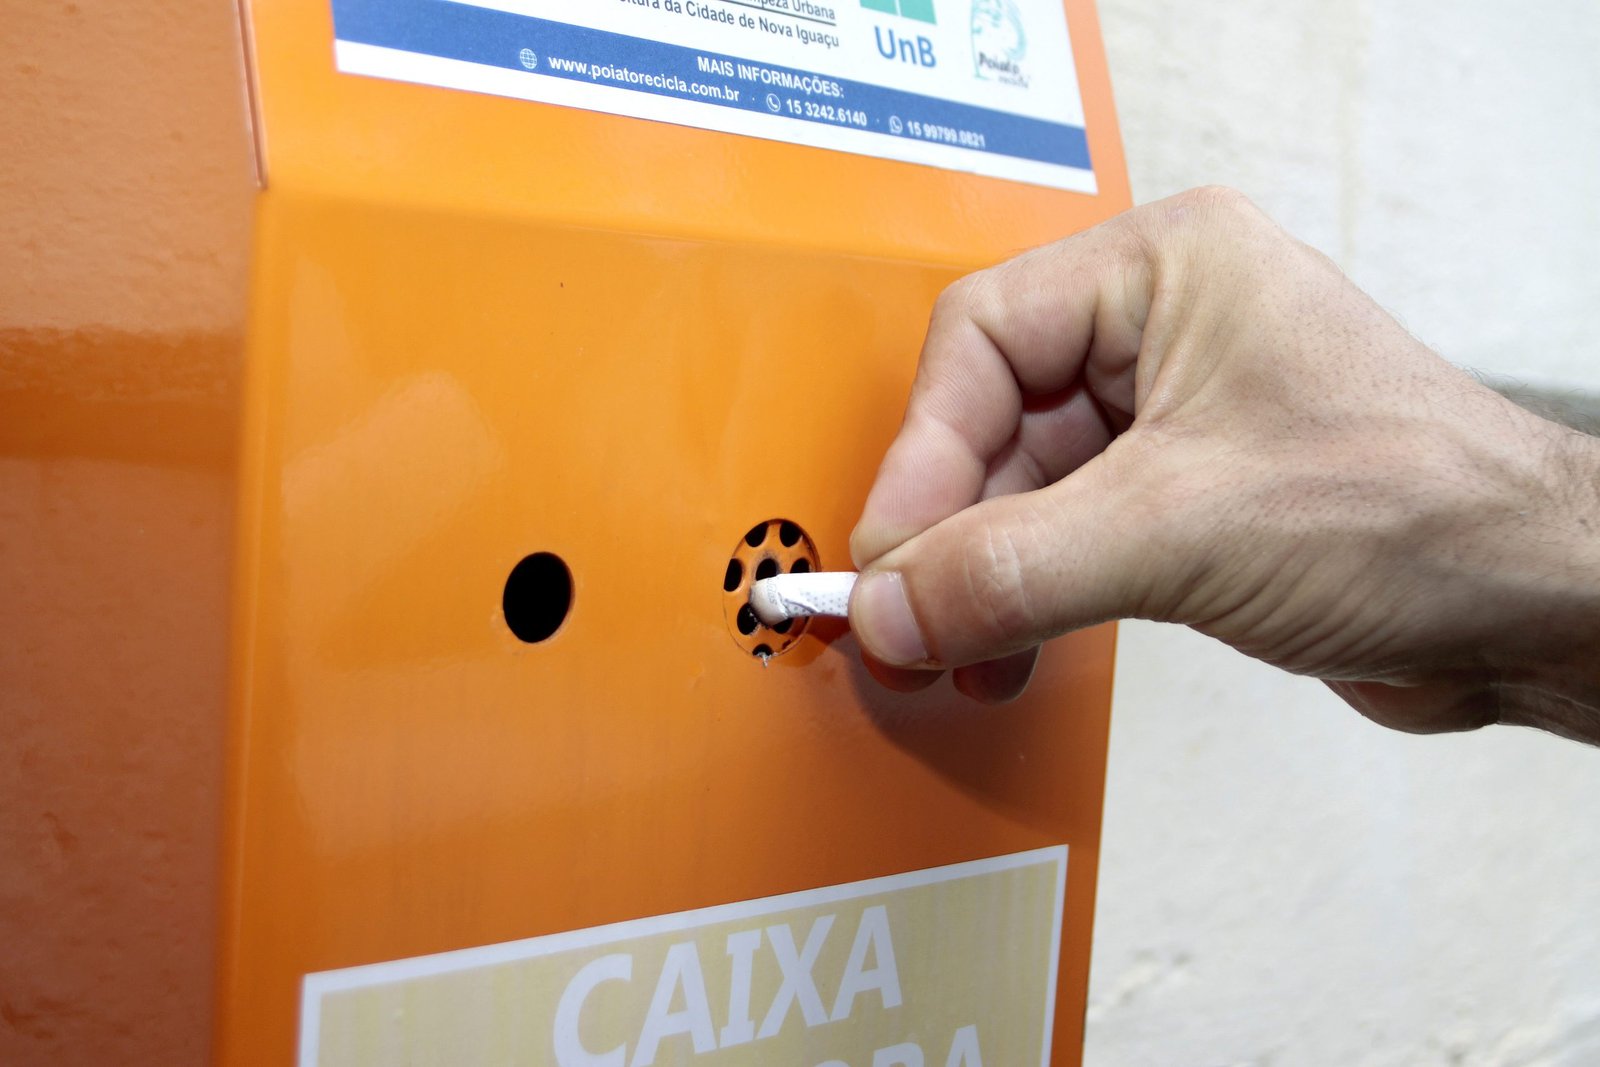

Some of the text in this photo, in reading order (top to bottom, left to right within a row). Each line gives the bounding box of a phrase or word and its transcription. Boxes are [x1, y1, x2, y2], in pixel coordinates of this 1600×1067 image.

[665, 0, 682, 14] da
[686, 1, 735, 25] Cidade
[738, 13, 755, 29] de
[758, 16, 793, 37] Nova
[796, 24, 840, 49] Iguaçu
[749, 0, 836, 20] peza Urbana
[874, 25, 937, 68] UnB
[548, 56, 740, 101] www.poiatorecicla.com.br
[786, 98, 802, 114] 15
[805, 102, 867, 126] 3242.6140
[907, 120, 922, 136] 15
[697, 56, 845, 98] MAIS INFORMAÇÕES:
[553, 904, 903, 1067] CAIXA
